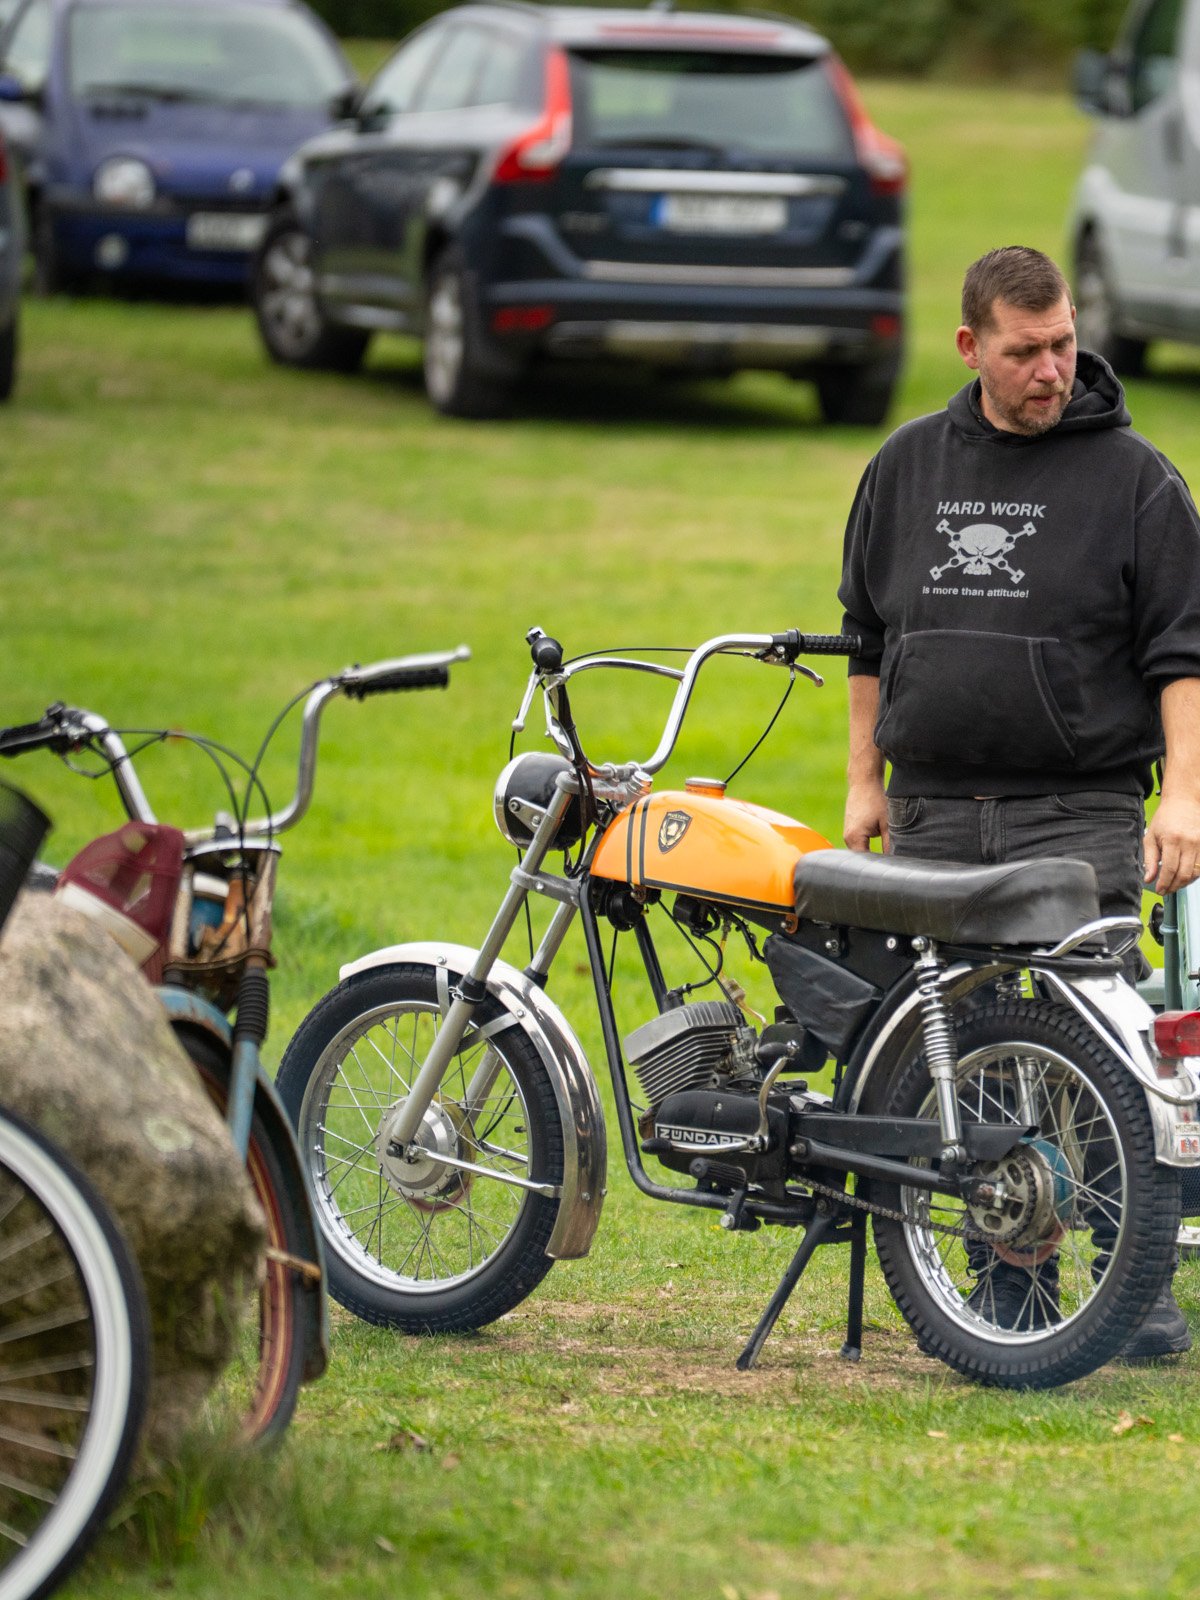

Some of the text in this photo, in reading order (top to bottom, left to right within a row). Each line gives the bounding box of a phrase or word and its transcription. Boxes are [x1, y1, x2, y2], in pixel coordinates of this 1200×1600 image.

[936, 501, 1047, 518] HARD WORK
[922, 586, 1030, 599] is more than attitude!
